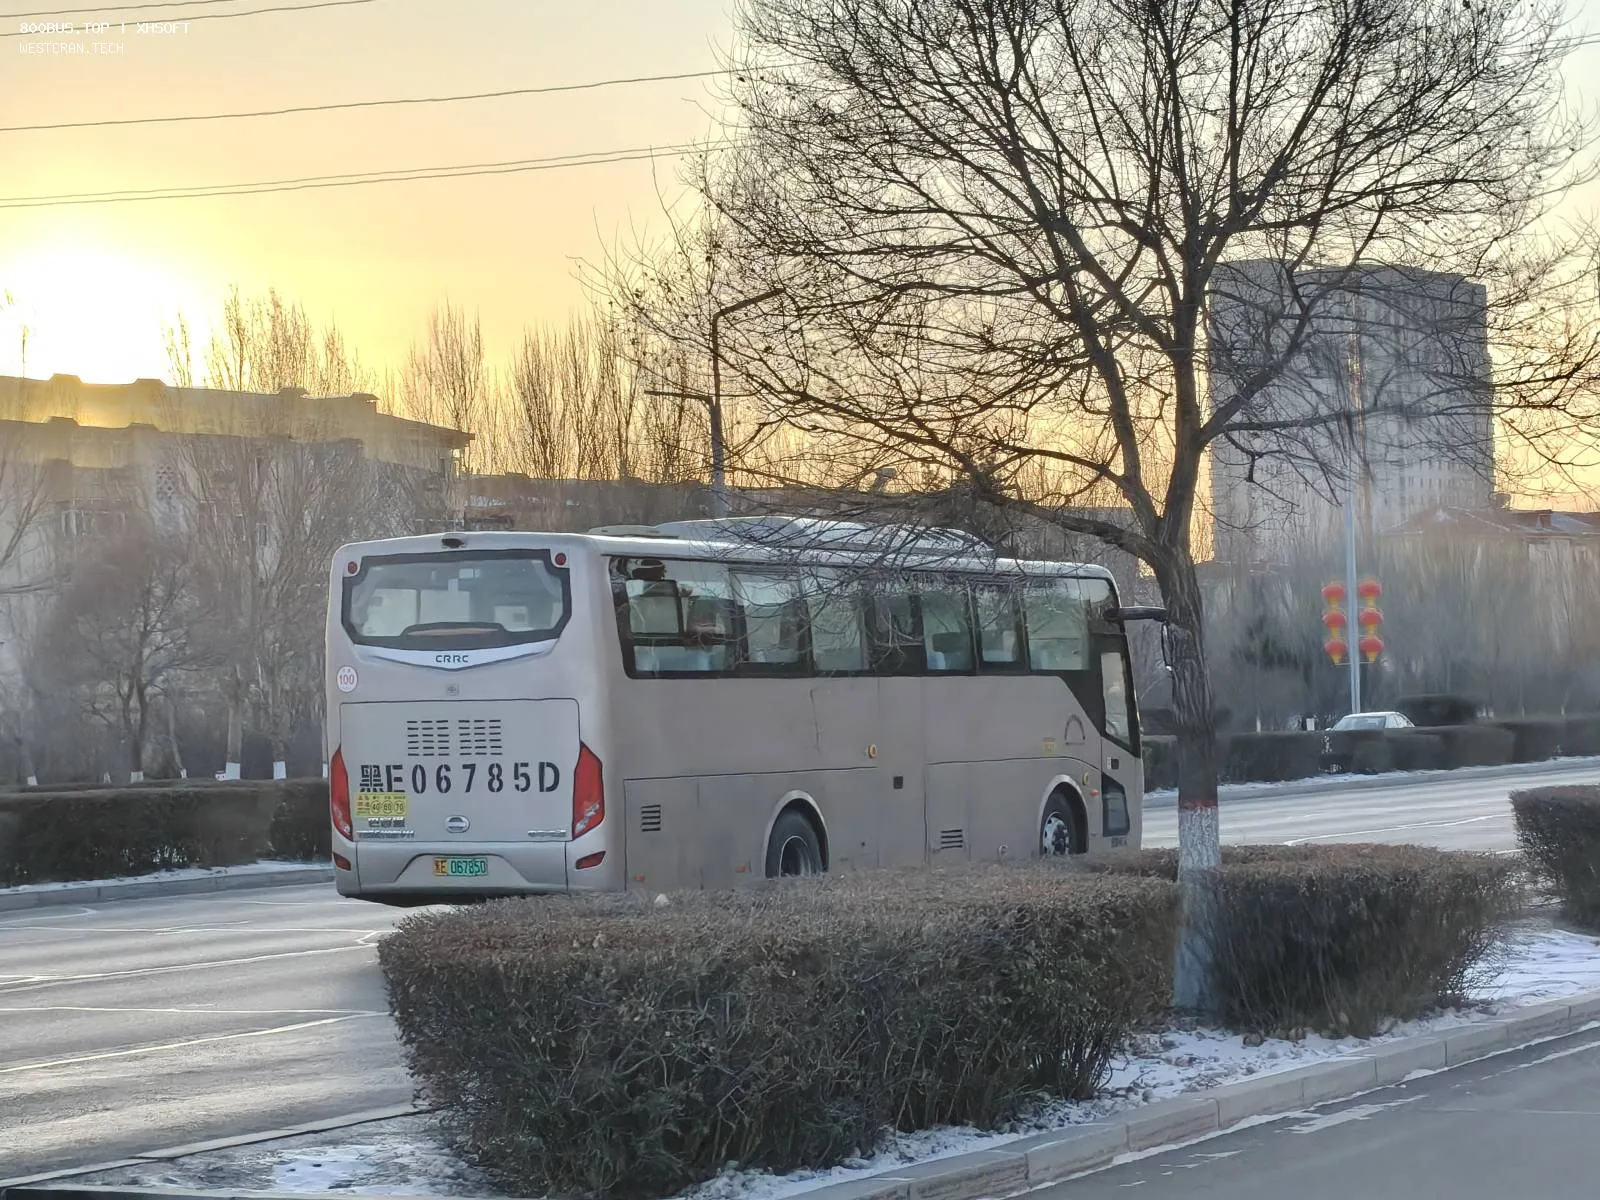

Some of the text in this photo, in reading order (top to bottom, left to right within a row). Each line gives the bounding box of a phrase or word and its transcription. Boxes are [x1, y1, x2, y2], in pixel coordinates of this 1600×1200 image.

[435, 654, 469, 664] CRRC
[339, 674, 355, 685] 100
[359, 761, 561, 794] 黑E06785D
